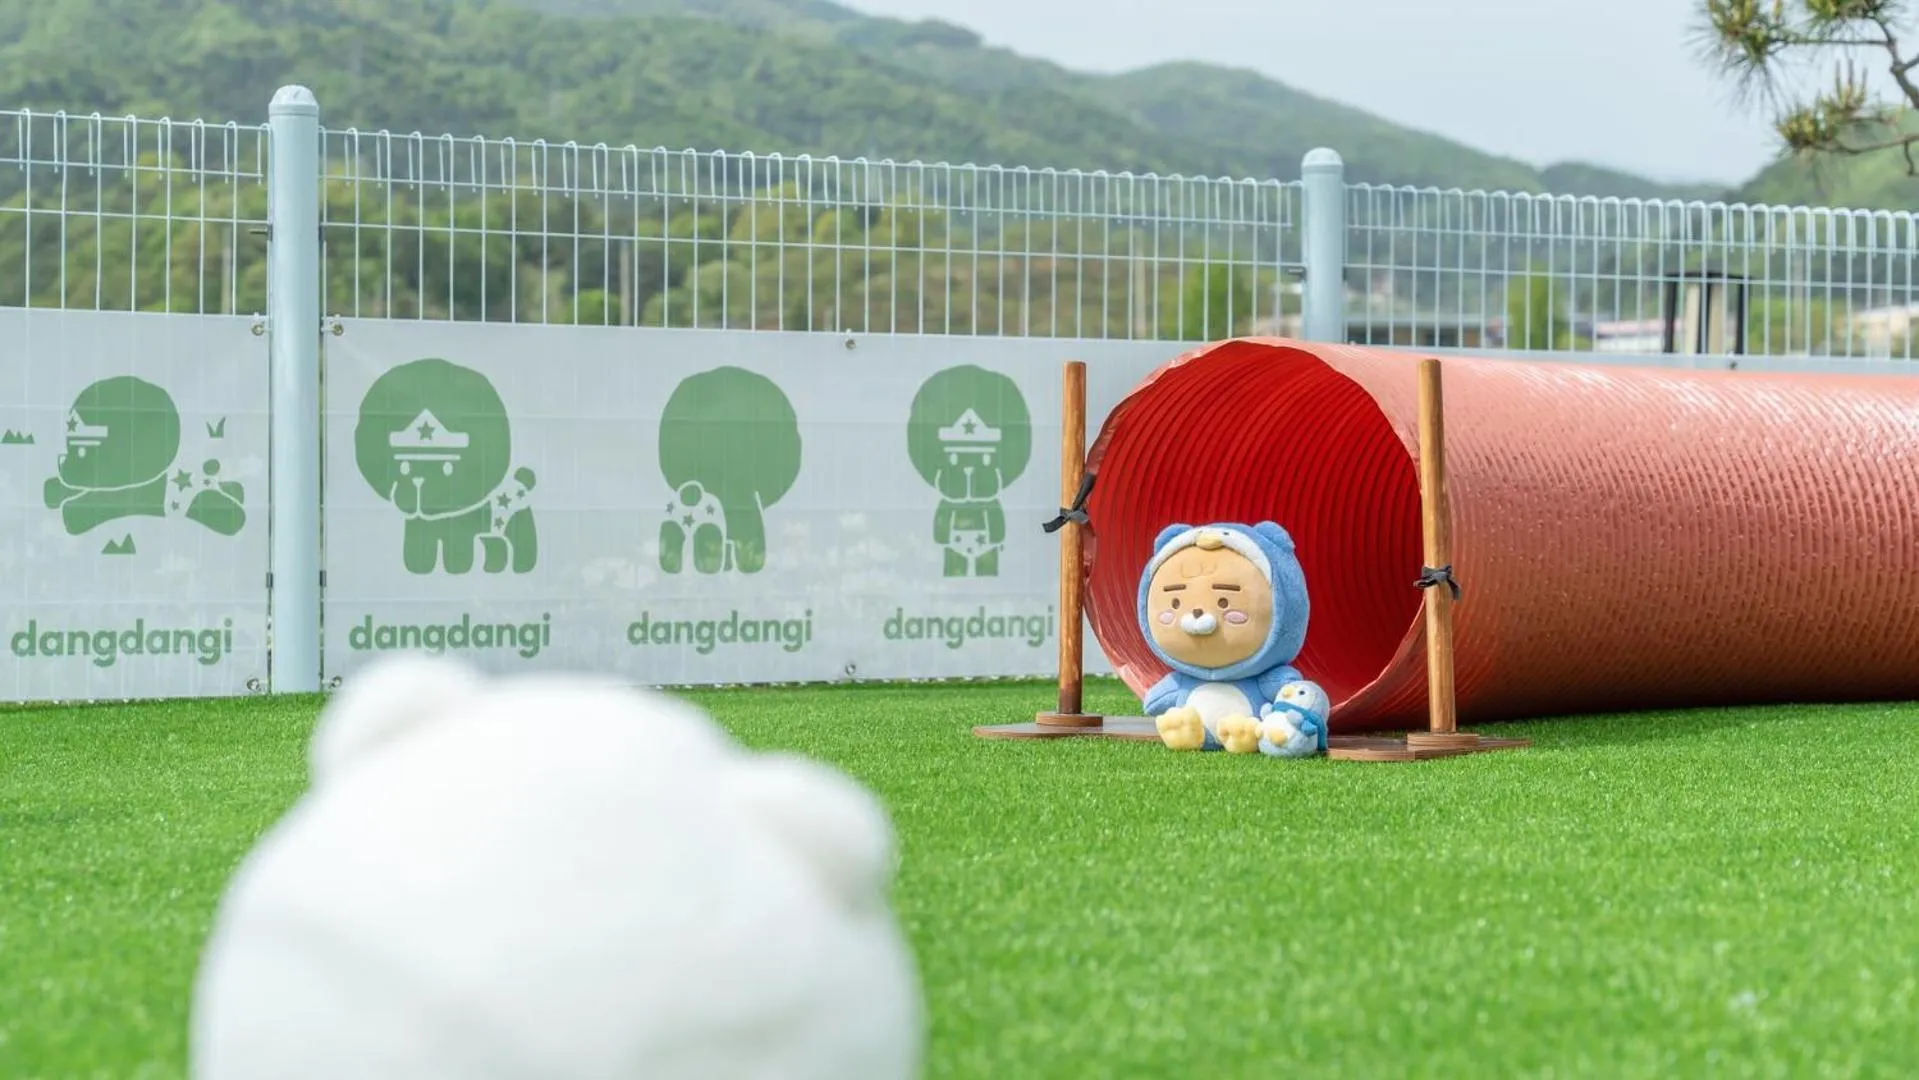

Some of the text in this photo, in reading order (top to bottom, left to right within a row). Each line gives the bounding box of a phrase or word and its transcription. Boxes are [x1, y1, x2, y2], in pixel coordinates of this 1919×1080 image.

[11, 619, 233, 667] dangdangi
[349, 612, 551, 658] dangdangi
[627, 609, 812, 654] dangdangi
[883, 605, 1054, 649] dangdangi
